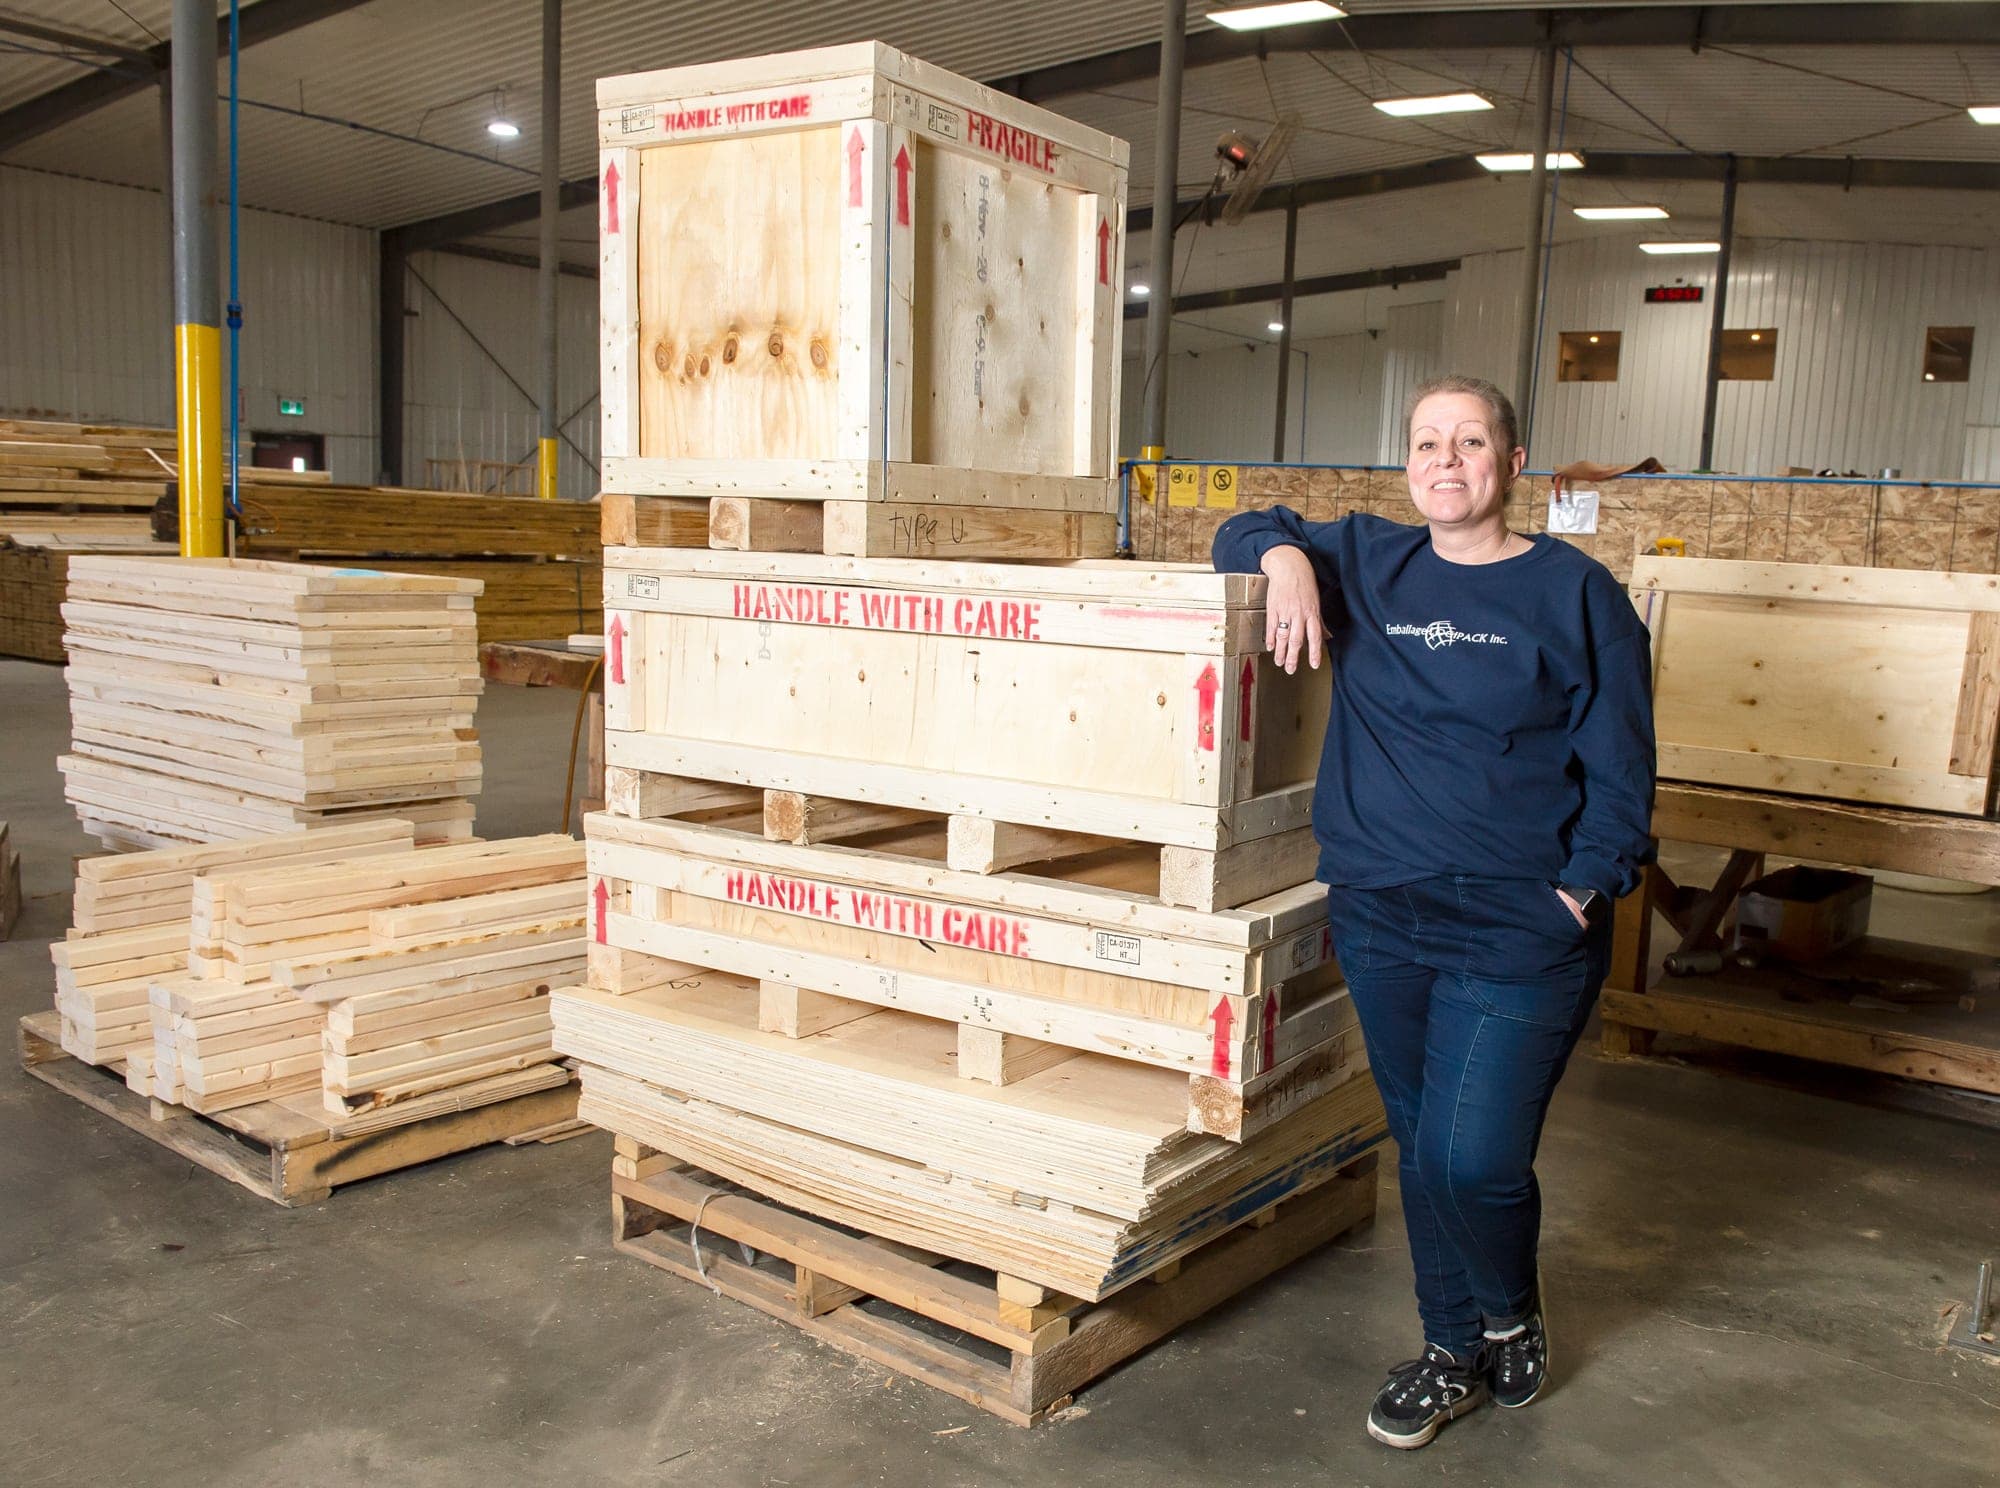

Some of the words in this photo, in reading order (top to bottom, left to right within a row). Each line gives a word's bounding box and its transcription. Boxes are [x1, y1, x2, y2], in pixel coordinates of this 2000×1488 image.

[665, 107, 722, 132] HANDLE
[727, 103, 765, 124] WITH
[769, 95, 811, 119] CARE
[967, 109, 1055, 174] FRAGILE
[951, 517, 964, 544] U
[733, 584, 850, 625] HANDLE
[861, 593, 944, 633] WITH
[954, 598, 1041, 641] CARE
[1386, 623, 1427, 638] Emballage
[1489, 634, 1508, 645] Inc.
[726, 870, 841, 920] HANDLE
[851, 890, 932, 938] WITH
[942, 907, 1032, 958] CARE
[1109, 938, 1138, 950] CA-01371
[1119, 951, 1128, 959] HT
